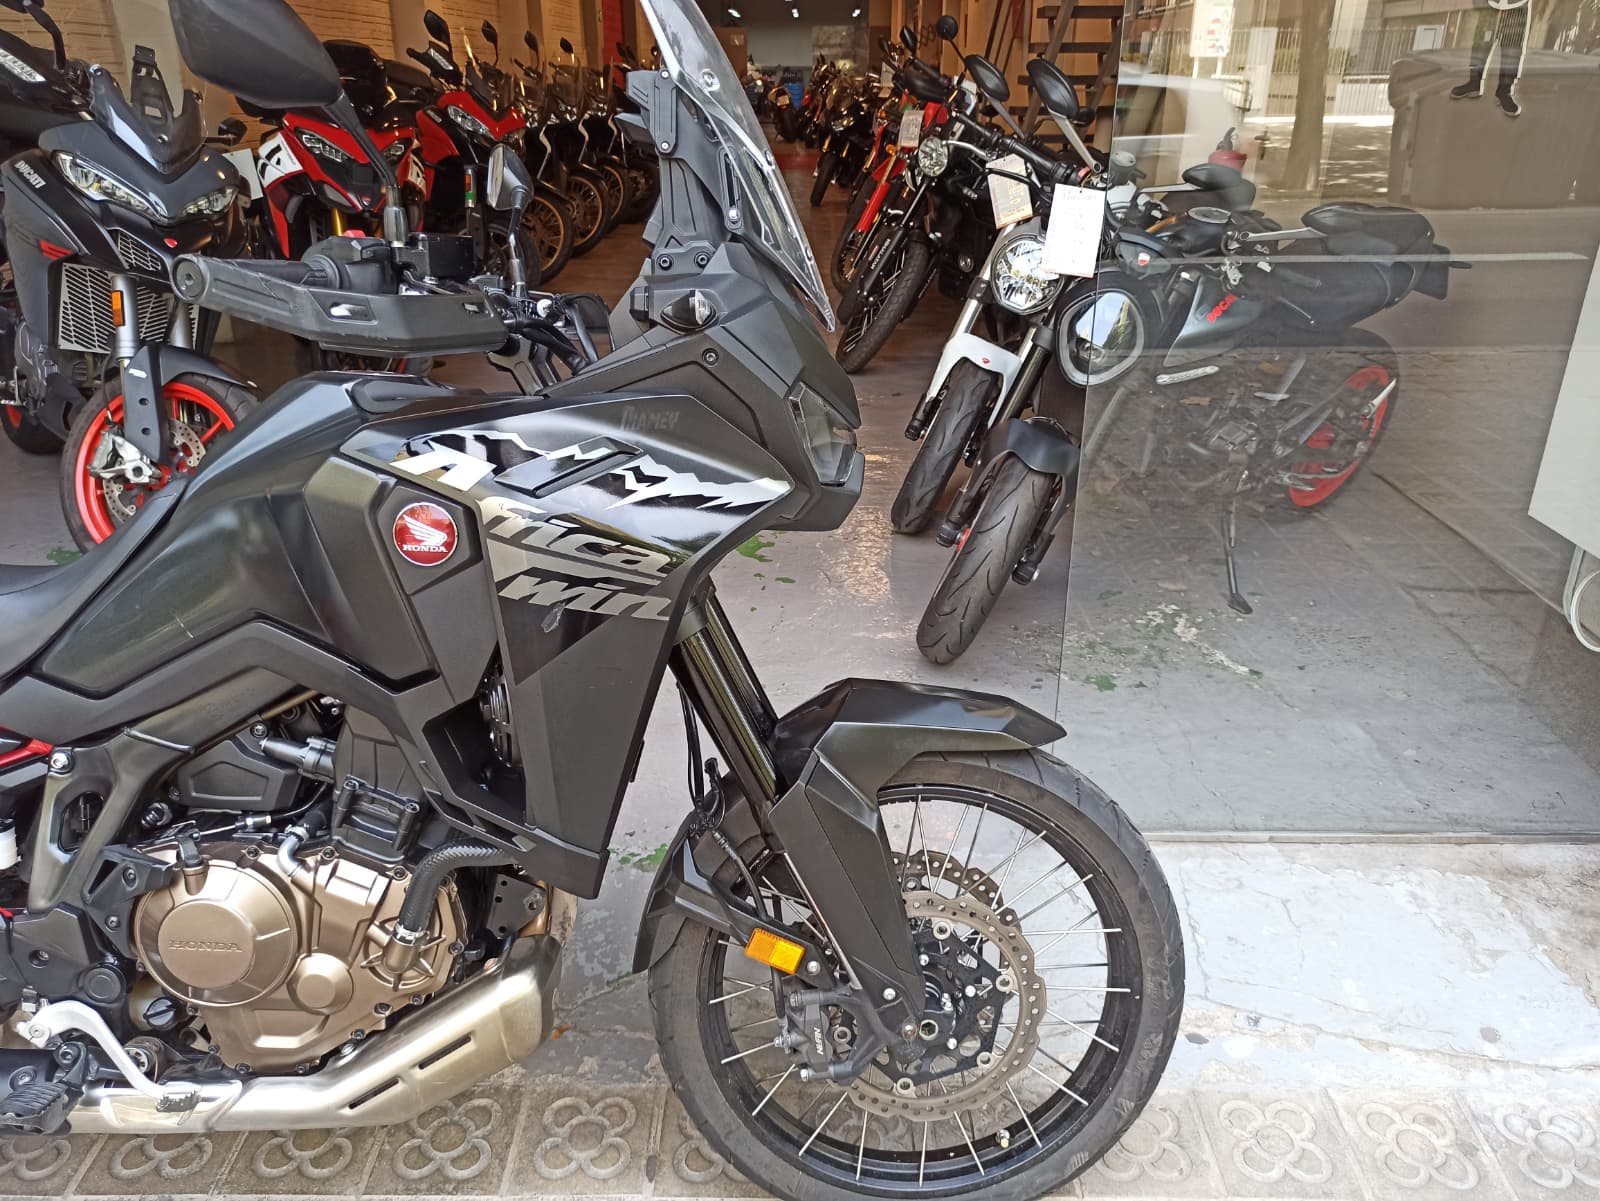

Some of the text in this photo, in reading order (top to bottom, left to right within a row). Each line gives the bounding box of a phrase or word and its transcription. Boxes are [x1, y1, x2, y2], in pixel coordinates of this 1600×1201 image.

[14, 160, 47, 189] DUCATI
[402, 544, 449, 553] HONDA
[167, 939, 243, 953] HONDA
